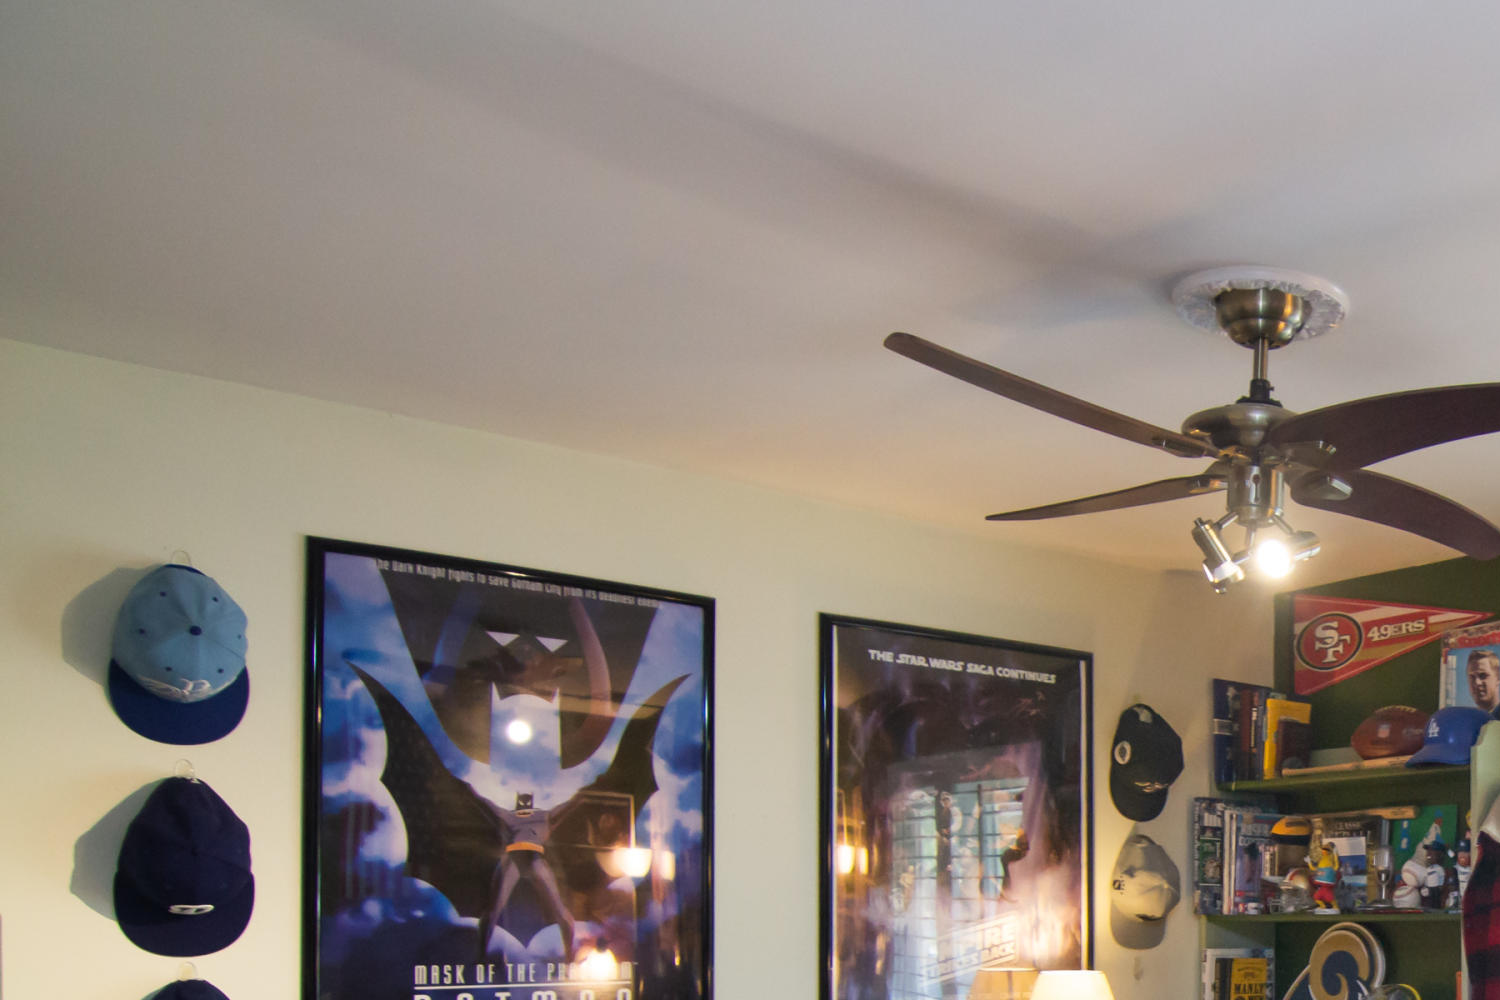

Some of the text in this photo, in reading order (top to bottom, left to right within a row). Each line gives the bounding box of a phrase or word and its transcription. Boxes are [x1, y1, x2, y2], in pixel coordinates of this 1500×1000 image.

[1367, 618, 1427, 642] 49ERS
[868, 649, 1057, 684] THE STAR WARS SAGA CONTINUES
[414, 962, 537, 985] MASK OF THE
[1234, 983, 1266, 995] MANLY
